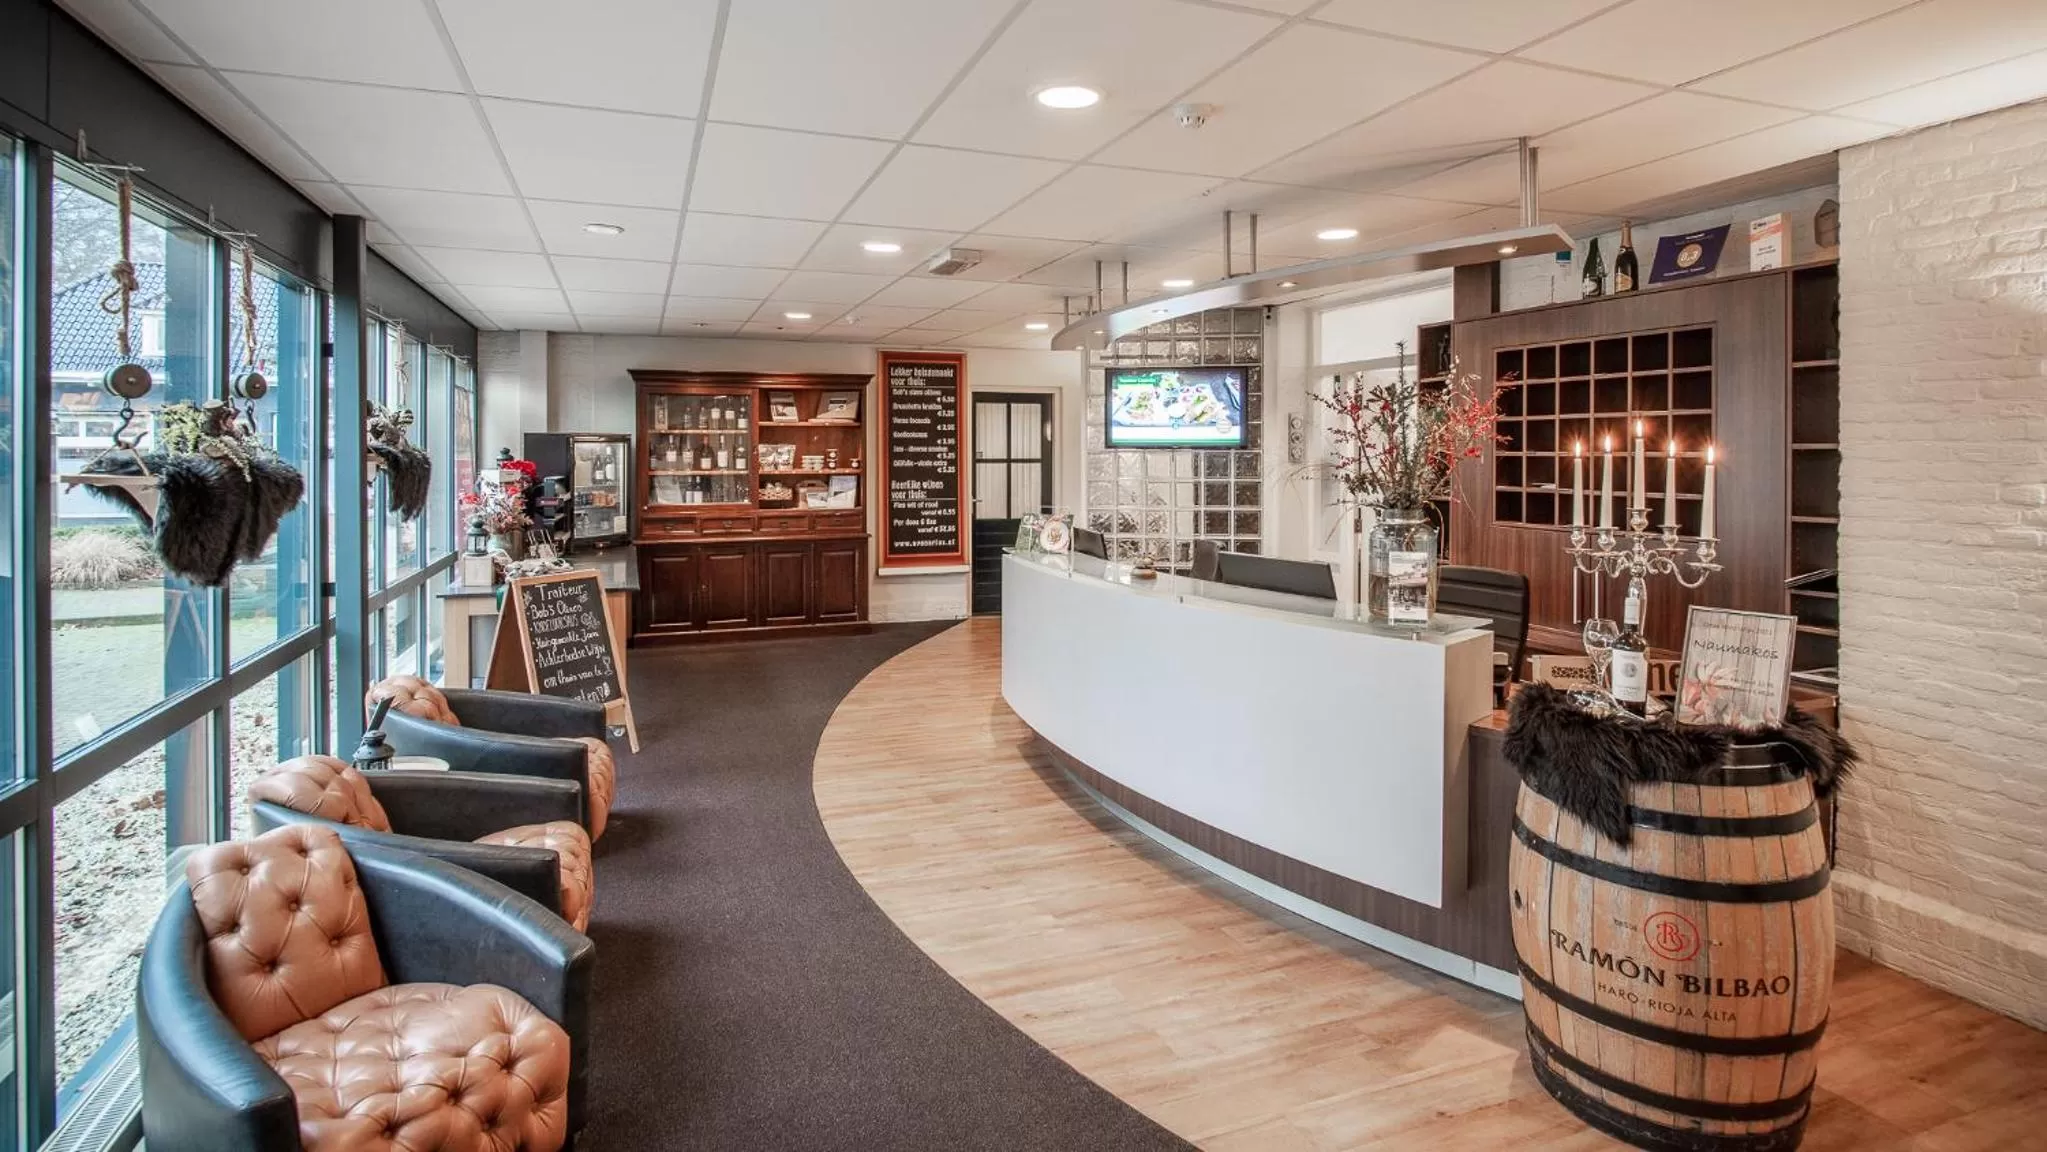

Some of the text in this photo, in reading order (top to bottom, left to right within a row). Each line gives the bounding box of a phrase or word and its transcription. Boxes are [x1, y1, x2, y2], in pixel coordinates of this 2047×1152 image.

[891, 377, 905, 386] voor
[891, 491, 906, 499] voor
[535, 583, 584, 601] Traiteur
[1551, 928, 1790, 998] RAMÓN BILBAO
[1598, 982, 1737, 1022] HARO RIOJA ALTA
